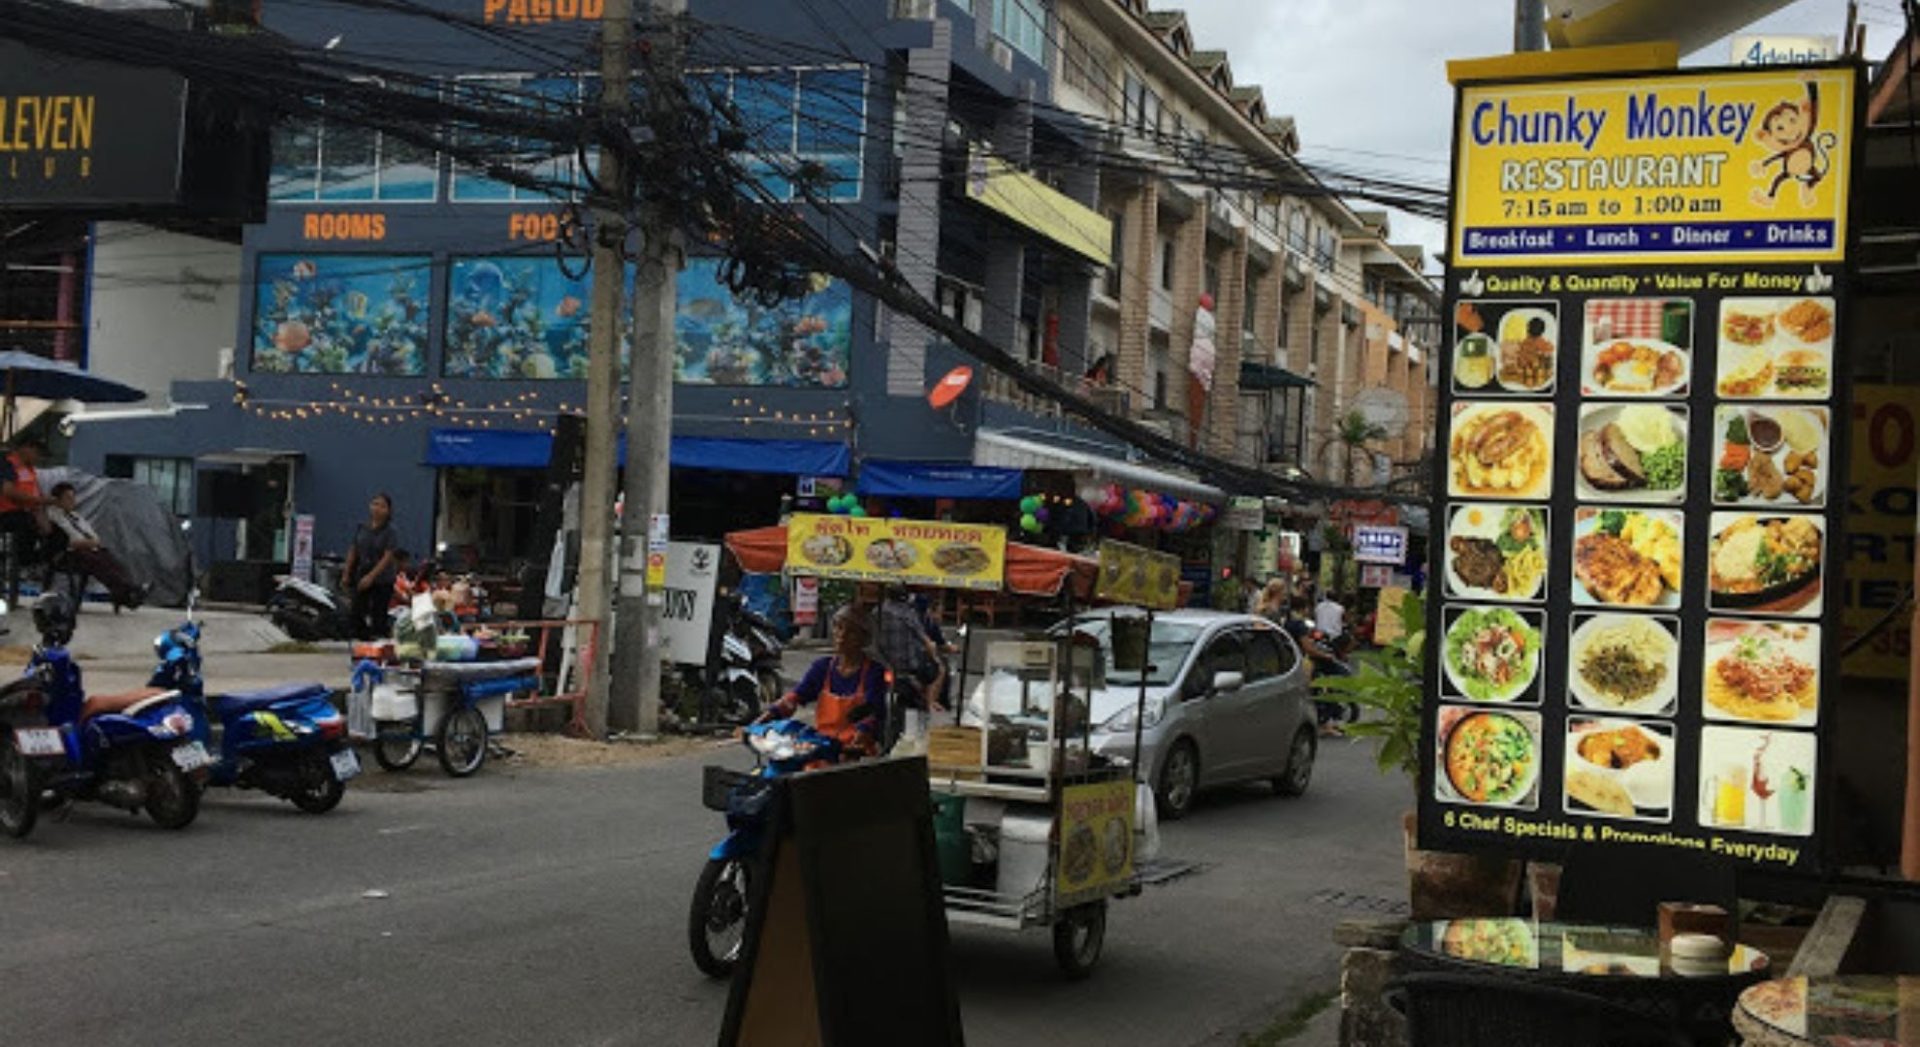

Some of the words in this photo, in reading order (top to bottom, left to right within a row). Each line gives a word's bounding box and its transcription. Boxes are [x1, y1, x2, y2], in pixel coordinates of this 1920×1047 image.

[1471, 96, 1607, 150] Chunky
[1628, 89, 1755, 143] Monkey
[1501, 151, 1728, 193] RESTAURANT
[1502, 198, 1551, 217] 7:15
[1599, 199, 1621, 214] to
[1634, 196, 1684, 214] 1:00
[304, 213, 386, 240] ROOMS
[508, 212, 574, 240] FOO
[1468, 229, 1555, 249] Breakfast
[1586, 227, 1639, 246] Lunch
[1671, 225, 1731, 244] Dinner
[1767, 223, 1828, 243] Drinks
[1486, 275, 1544, 294] Quality
[1549, 275, 1561, 291] &
[1566, 273, 1639, 294] Quantity
[1655, 272, 1703, 289] Value
[1707, 271, 1738, 288] For
[1743, 271, 1803, 291] Money
[1459, 812, 1500, 831] Chef
[1504, 816, 1578, 840] Specials
[1583, 823, 1596, 841] &
[1711, 836, 1800, 867] Everyday
